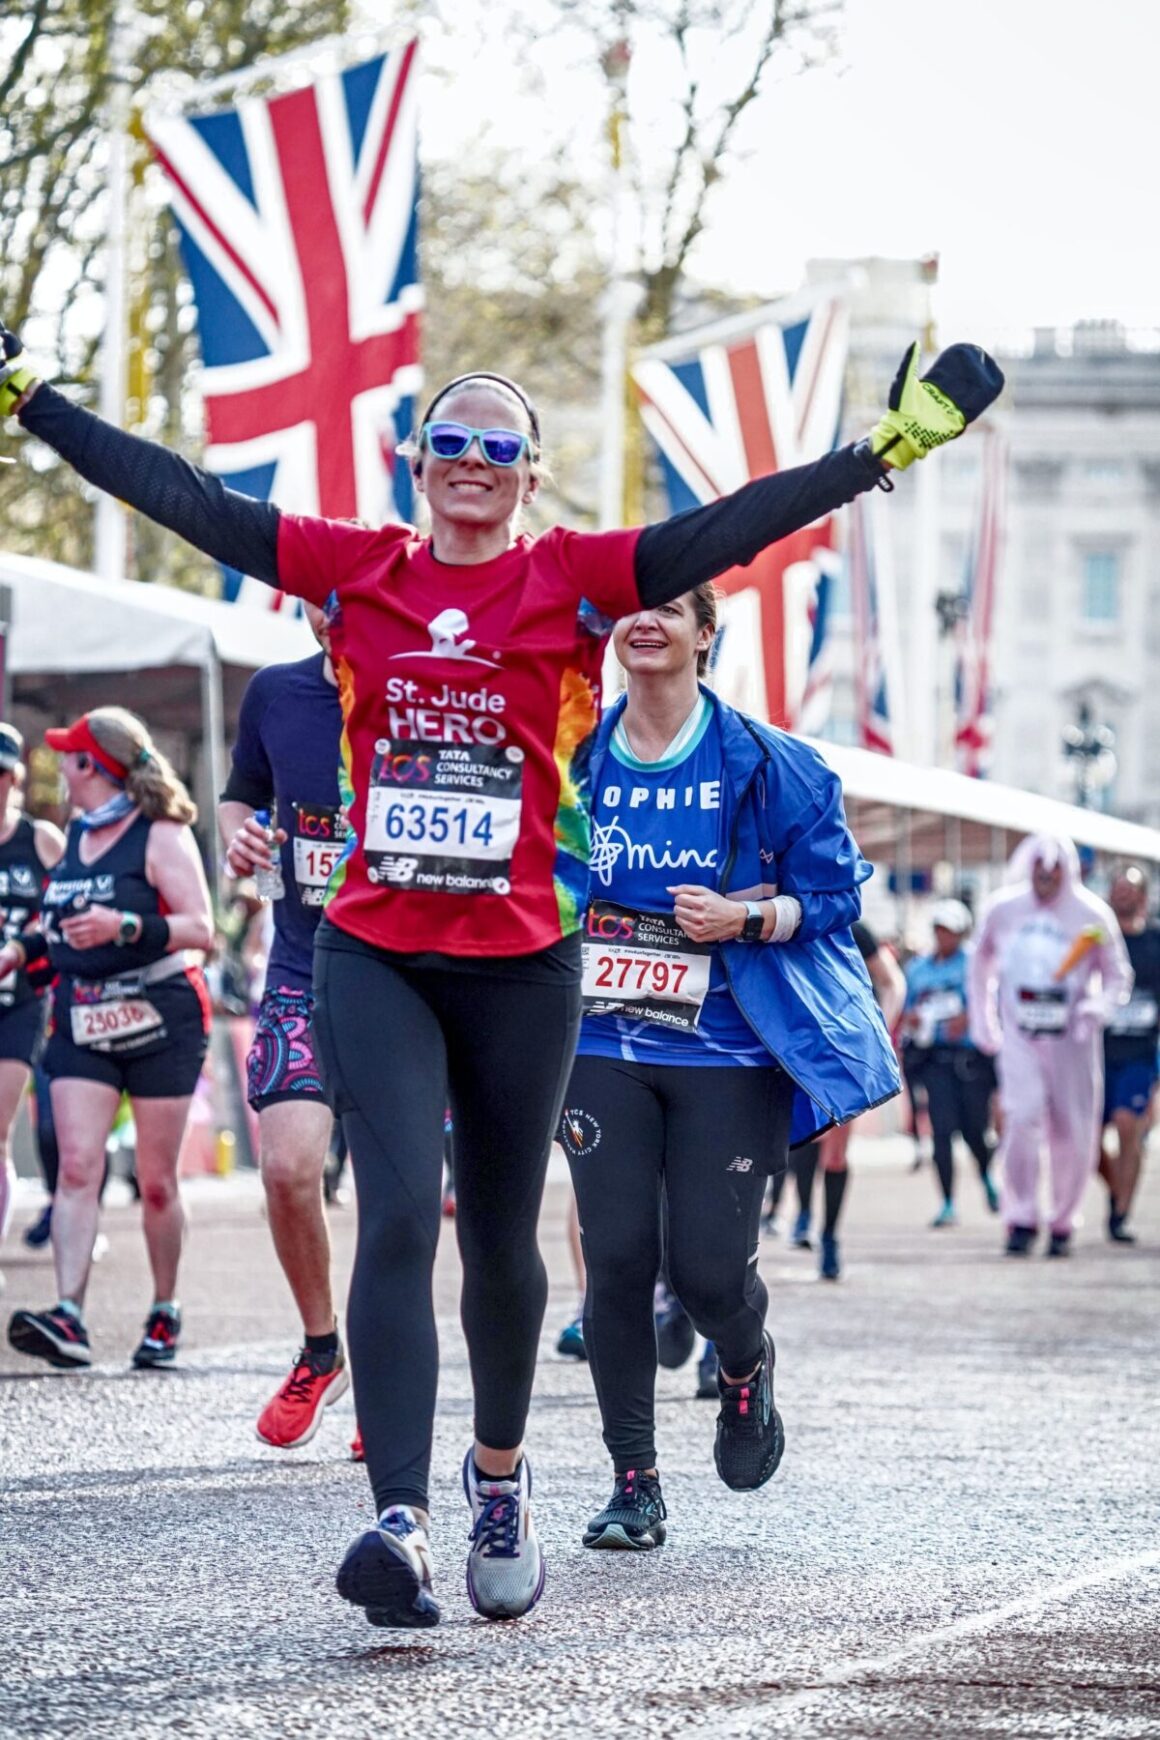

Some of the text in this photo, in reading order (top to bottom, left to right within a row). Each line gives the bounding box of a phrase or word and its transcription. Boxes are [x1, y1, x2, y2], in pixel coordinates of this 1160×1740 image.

[385, 677, 506, 714] St. Jude
[388, 706, 506, 745] HERO
[438, 750, 471, 762] TATA
[434, 774, 484, 788] SERVICES
[436, 762, 513, 780] CONSULTANCY
[602, 780, 721, 810] OPHIE
[297, 808, 331, 838] tcs
[385, 802, 493, 847] 63514
[306, 850, 341, 878] 15
[416, 873, 444, 886] new
[587, 907, 635, 939] tcs
[638, 914, 666, 927] TATA
[637, 932, 680, 945] SERVICES
[595, 956, 689, 994] 27797
[644, 1006, 689, 1028] balance
